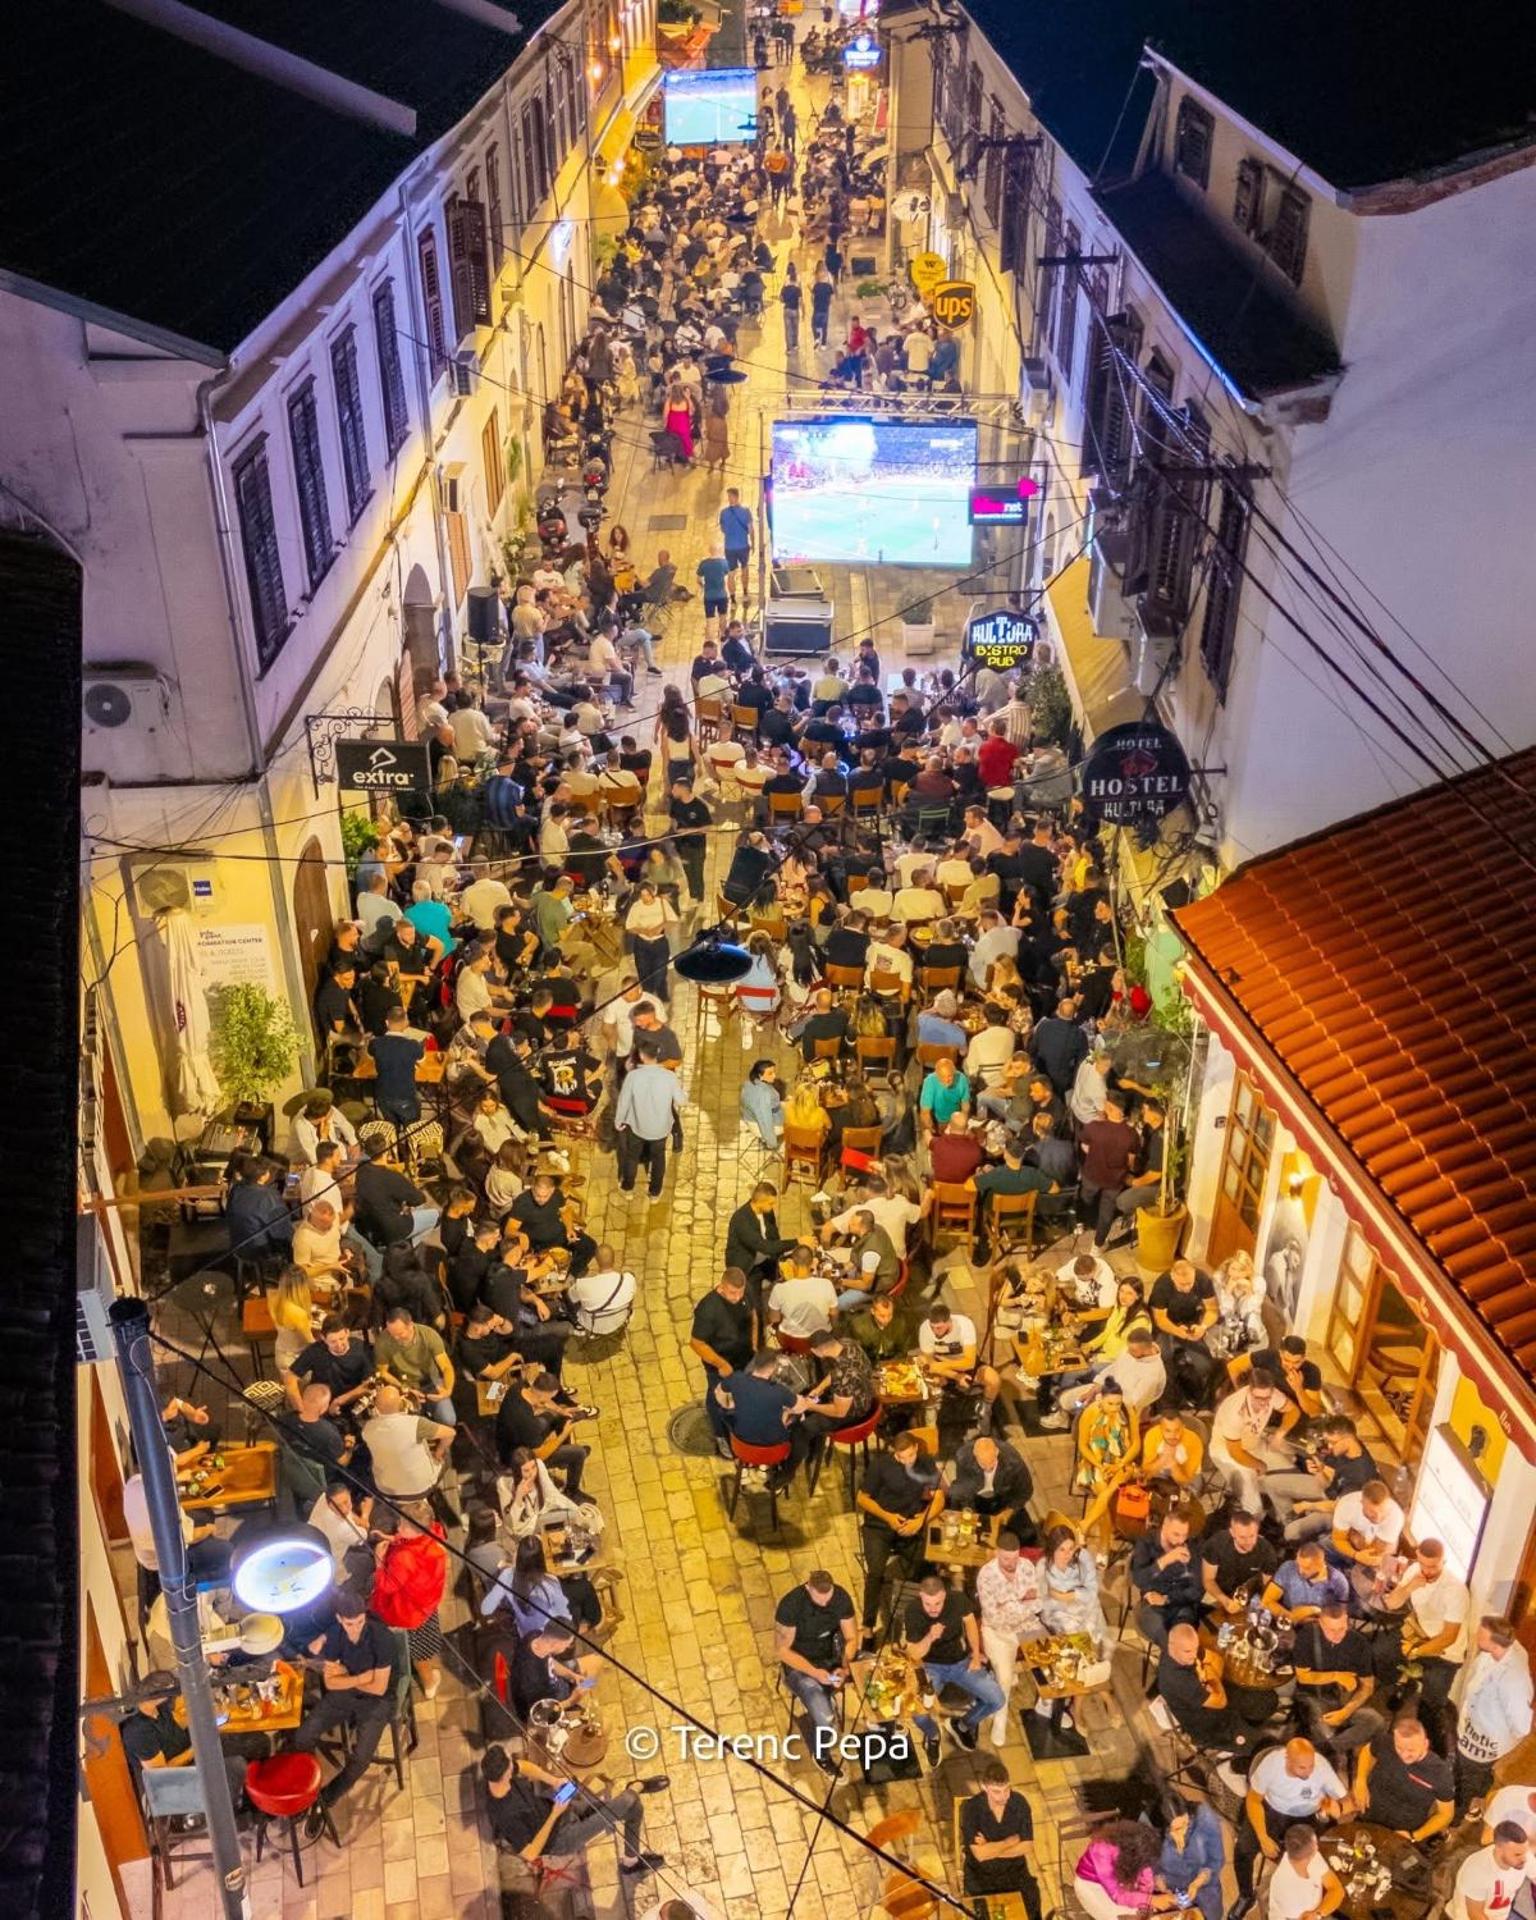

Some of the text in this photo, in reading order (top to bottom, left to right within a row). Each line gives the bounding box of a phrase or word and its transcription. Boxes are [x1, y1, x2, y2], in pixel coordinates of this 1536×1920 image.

[936, 297, 971, 324] ups
[973, 616, 1033, 644] KULTURA
[976, 645, 1028, 656] BISTRO
[987, 656, 1015, 667] PUB
[1116, 738, 1162, 750] HOTEL
[352, 769, 409, 785] extra
[1090, 776, 1184, 796] HOSTEL
